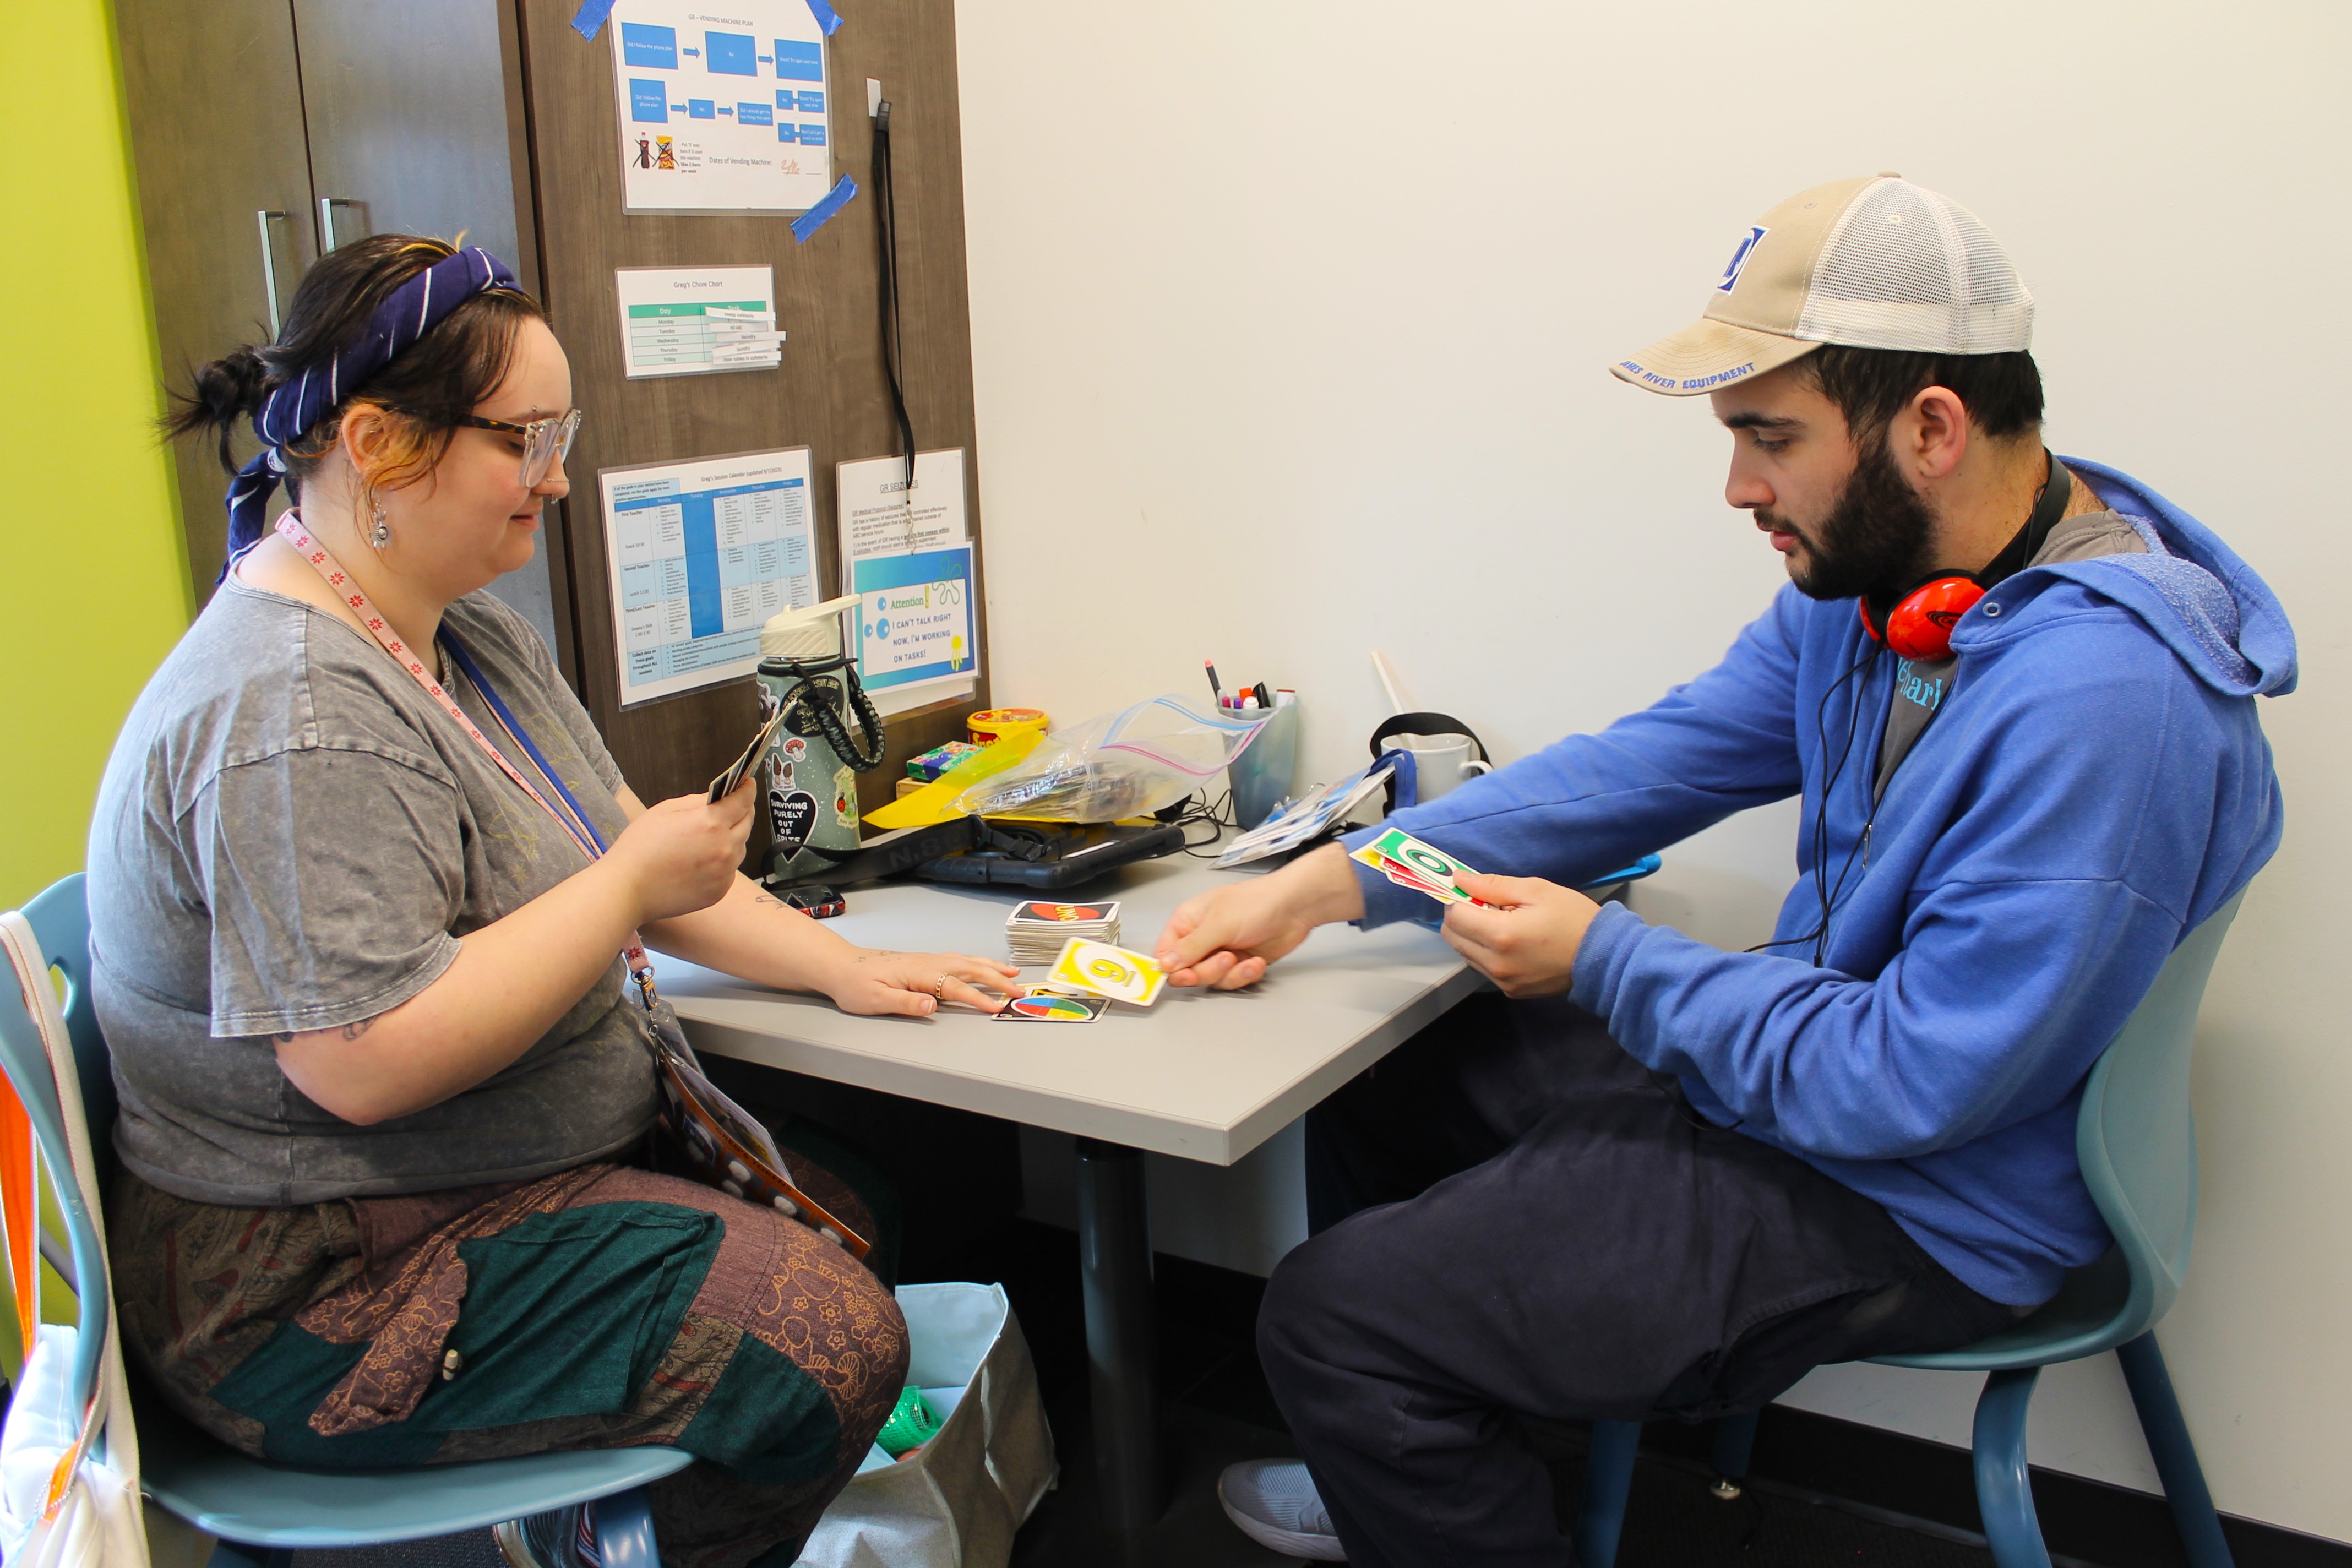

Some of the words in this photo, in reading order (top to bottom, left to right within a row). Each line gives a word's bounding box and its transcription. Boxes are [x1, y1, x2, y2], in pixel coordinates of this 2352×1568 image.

[730, 157, 750, 166] Vending
[1619, 360, 1644, 375] JAMES
[1642, 372, 1676, 389] RIVER
[1681, 362, 1756, 389] EQUIPMENT
[880, 484, 889, 493] GR
[896, 618, 914, 629] CAN'T
[916, 616, 931, 625] TALK
[933, 613, 951, 623] RIGHT
[892, 637, 910, 646] NOW,
[911, 634, 919, 643] I'M
[922, 630, 951, 640] WORKING
[894, 655, 902, 663] ON
[905, 649, 927, 661] TASKS!
[771, 799, 808, 810] SURVIVING
[774, 809, 803, 819] PURELY
[1054, 905, 1080, 922] UNO
[715, 1126, 749, 1159] GREG'S
[752, 1160, 792, 1192] TOKENS
